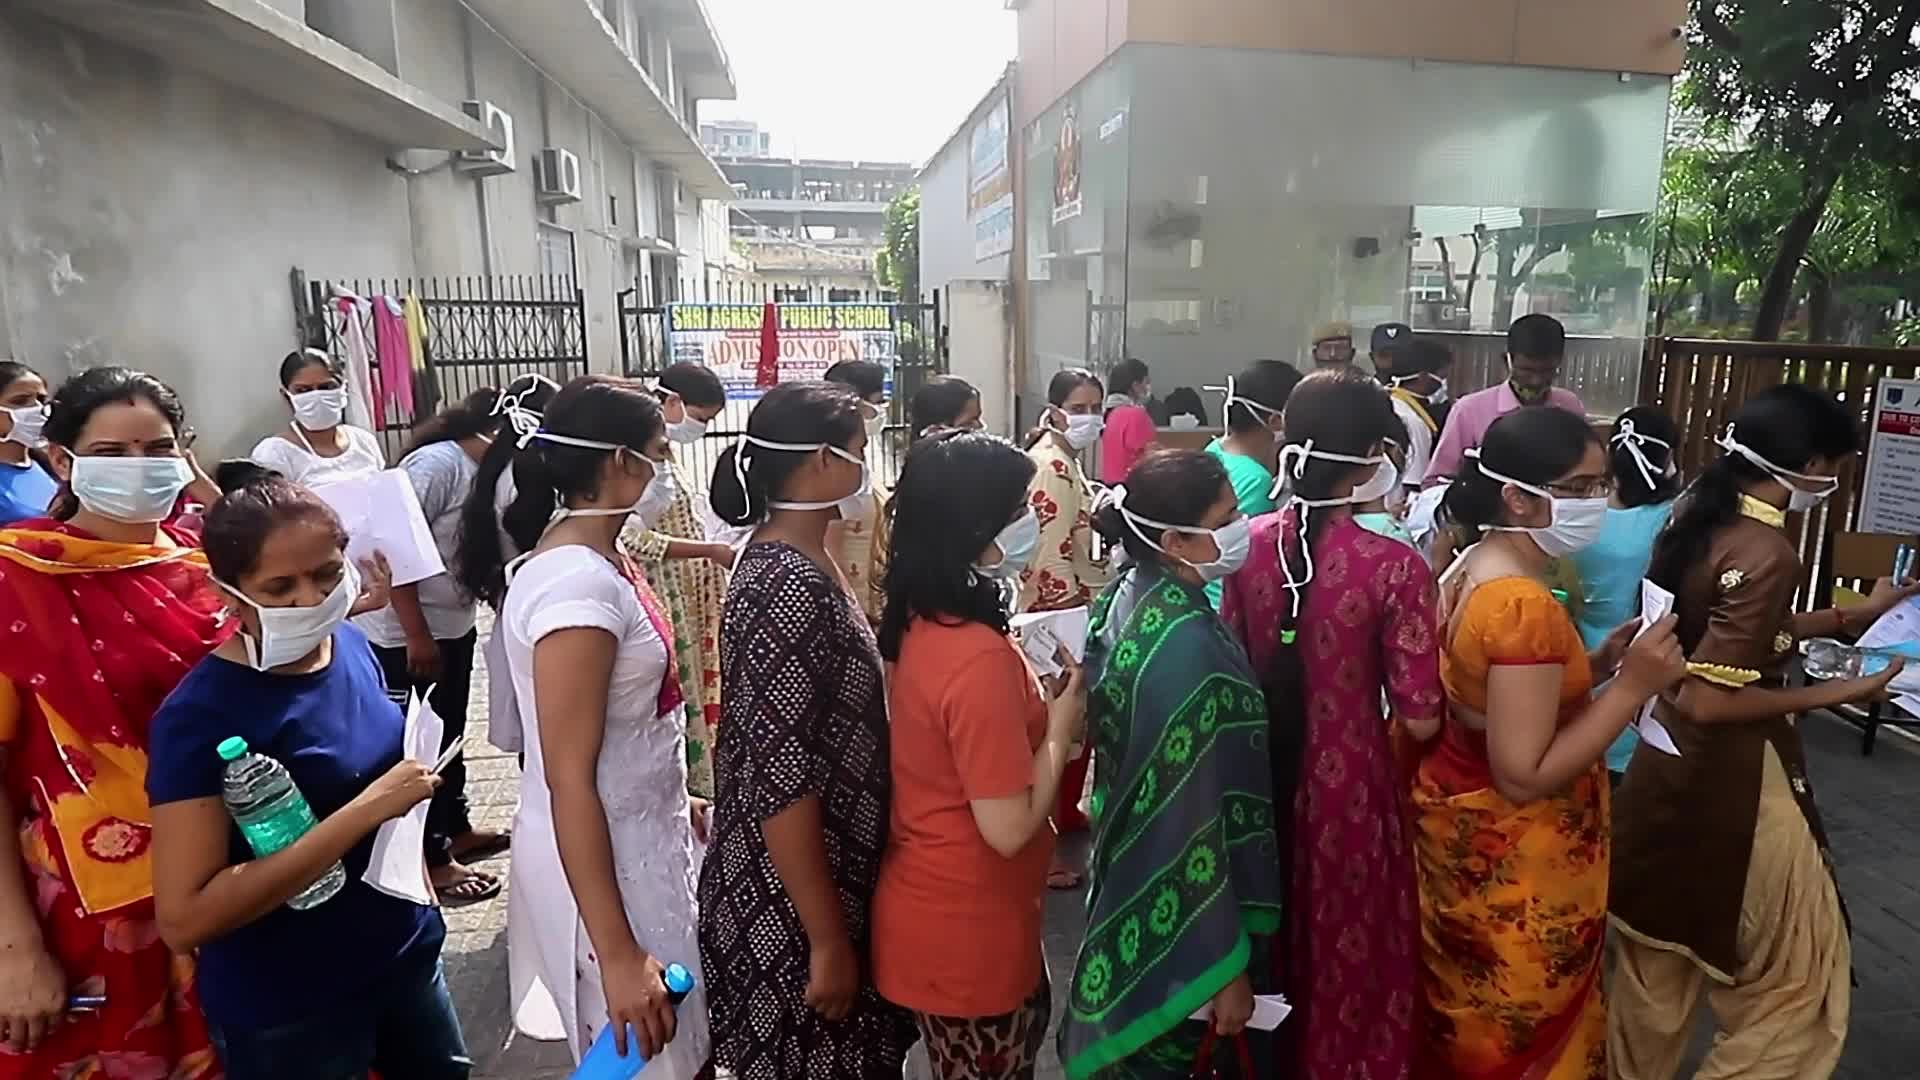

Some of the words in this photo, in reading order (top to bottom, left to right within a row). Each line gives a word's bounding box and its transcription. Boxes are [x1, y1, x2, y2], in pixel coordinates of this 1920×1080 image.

[672, 306, 707, 330] SHRI
[711, 306, 776, 330] AGRAS
[781, 306, 832, 329] PUBLIC
[834, 306, 891, 329] SCHOOL
[709, 338, 810, 366] ADMISION
[813, 338, 860, 361] OPEN
